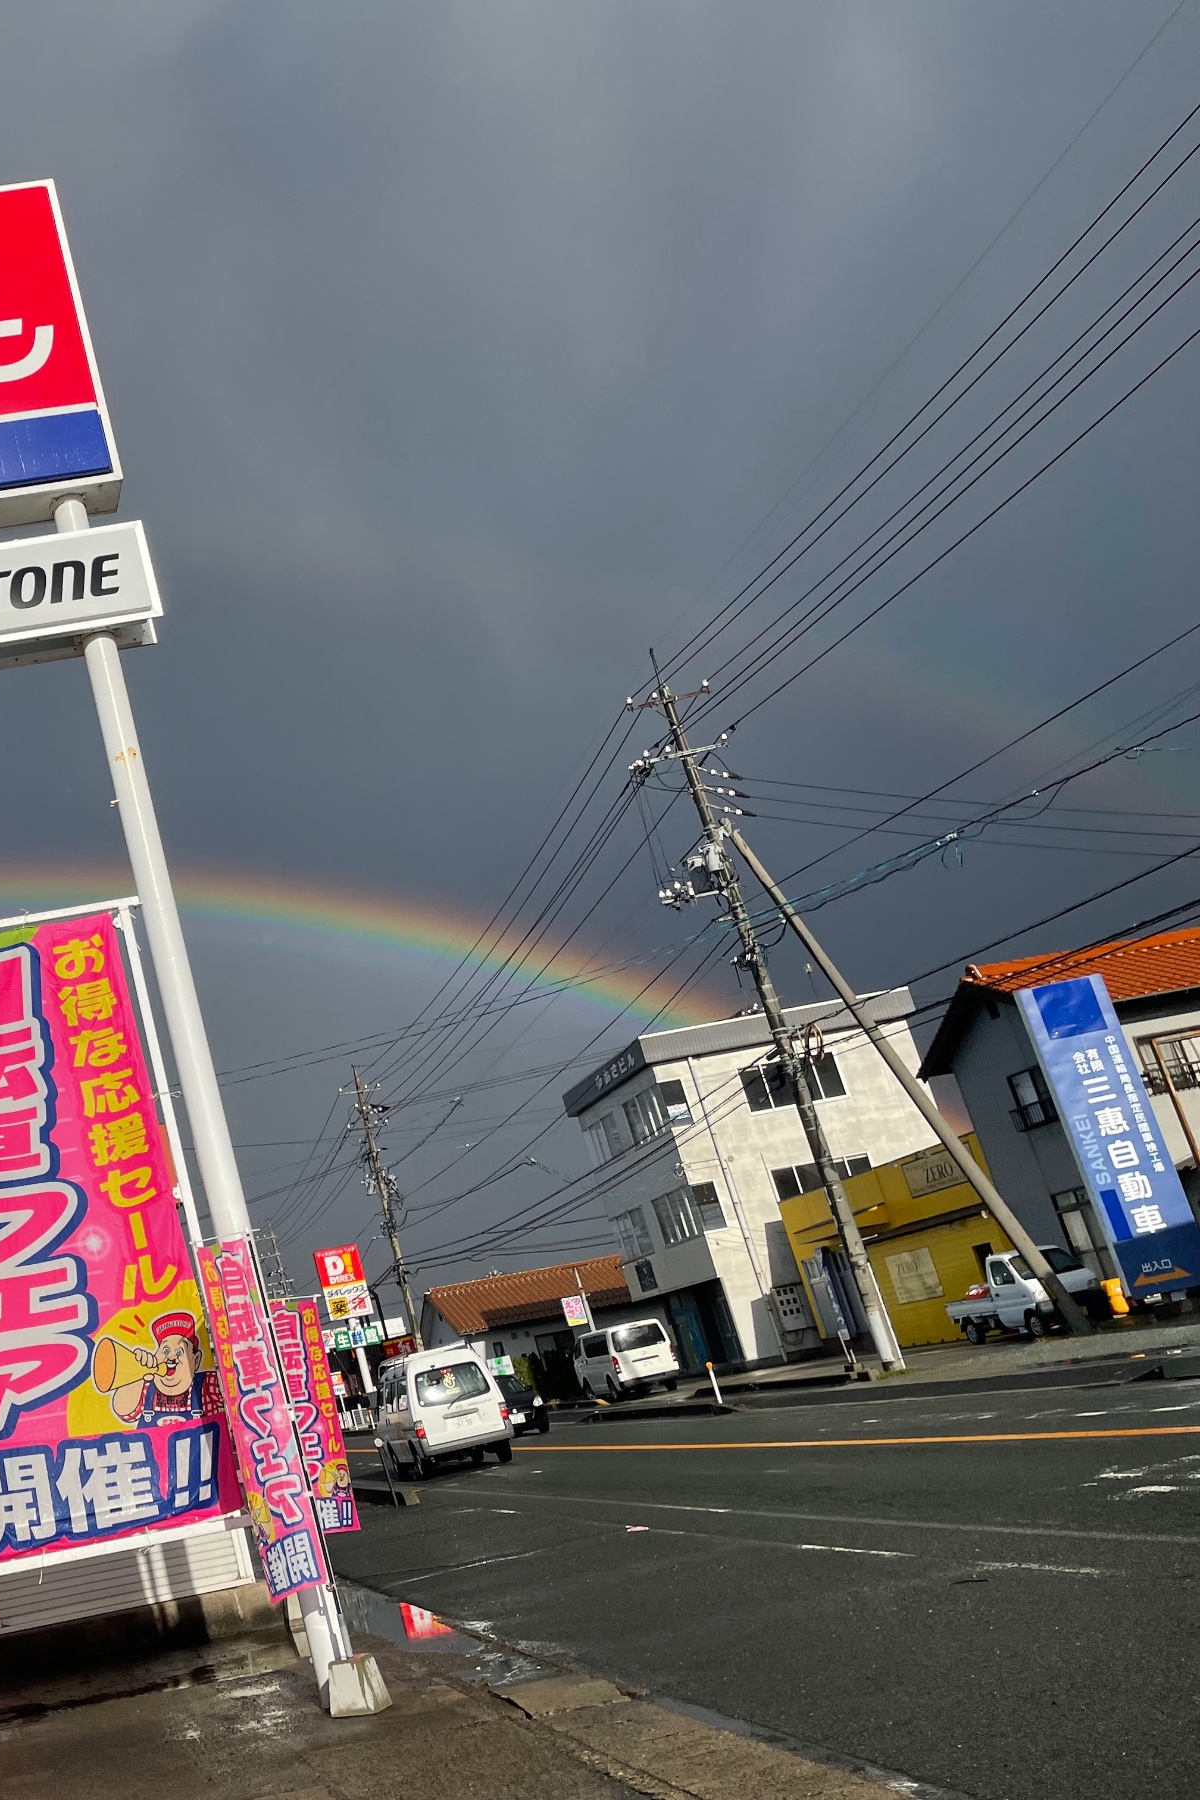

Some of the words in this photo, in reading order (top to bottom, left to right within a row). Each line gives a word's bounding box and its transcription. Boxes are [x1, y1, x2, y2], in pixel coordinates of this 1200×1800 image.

[53, 933, 178, 1301] お得な応援セール
[1073, 1113, 1111, 1185] SANKEI
[923, 1162, 954, 1185] ZERO
[1141, 1258, 1172, 1273] 出入口
[330, 1273, 356, 1285] DIREX
[337, 1328, 380, 1349] 生鮮館
[302, 1308, 340, 1453] お得な応援セール
